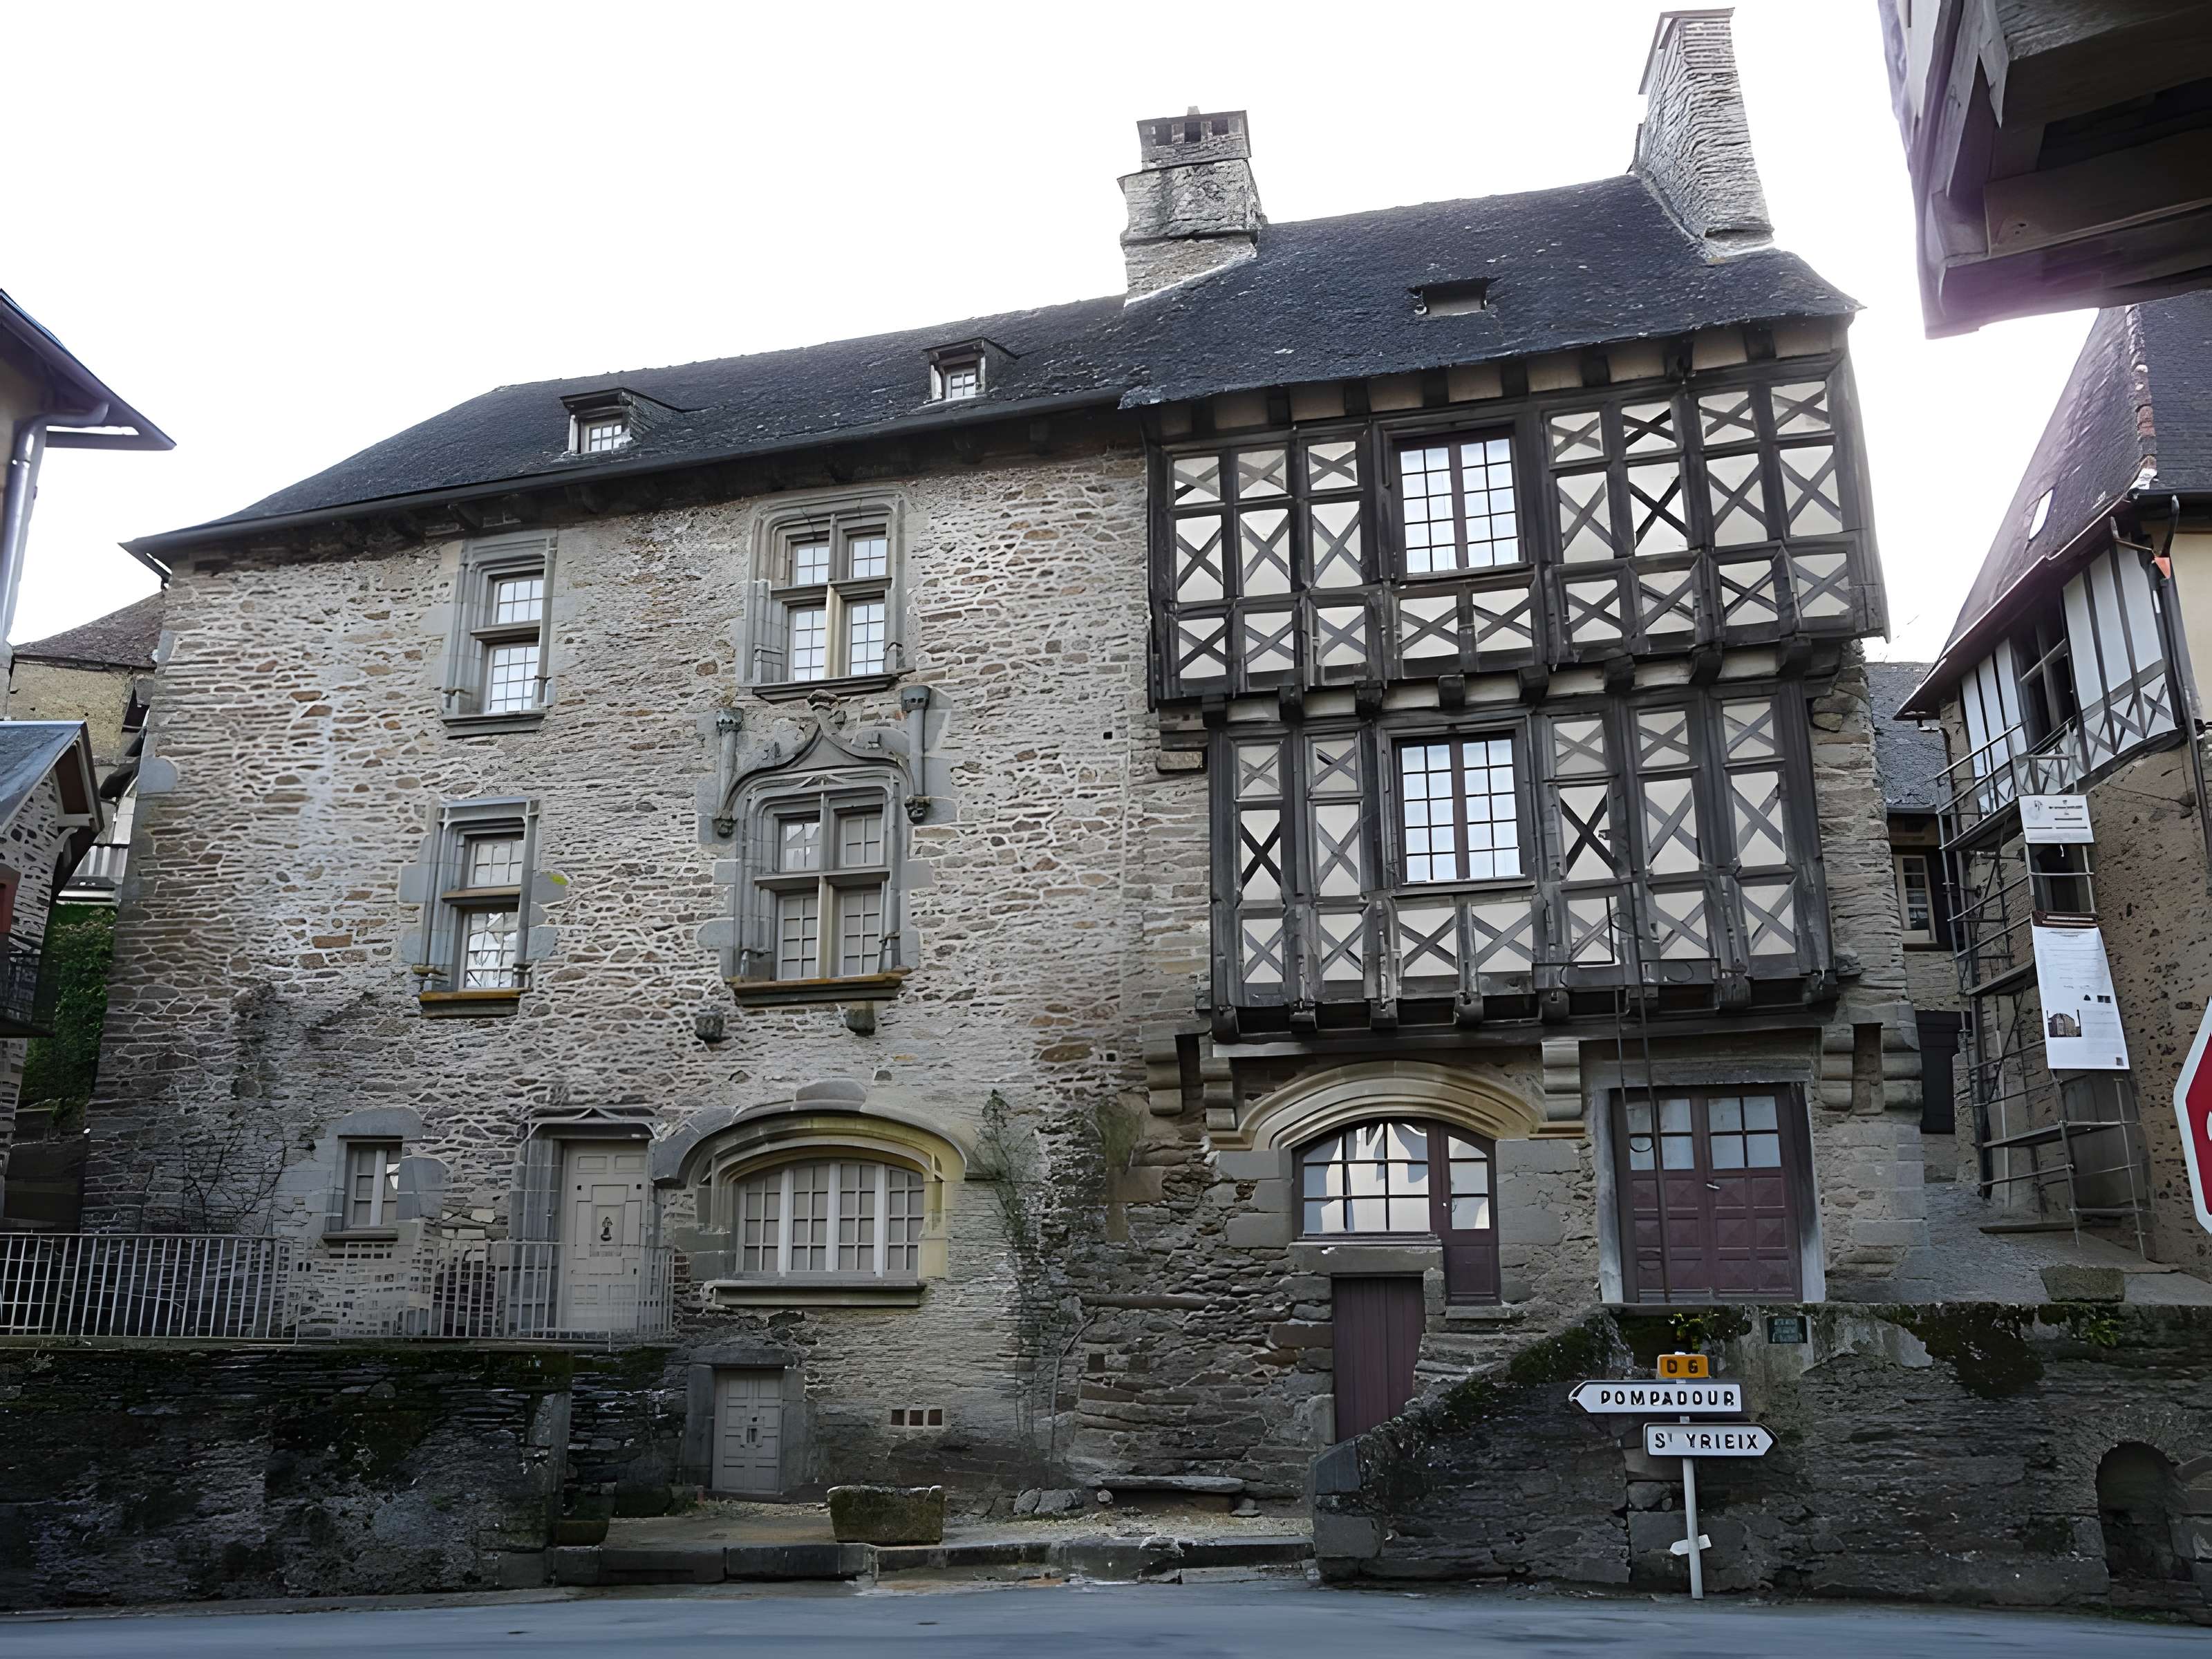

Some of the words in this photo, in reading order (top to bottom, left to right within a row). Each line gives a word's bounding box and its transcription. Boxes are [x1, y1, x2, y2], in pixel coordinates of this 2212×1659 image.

[1667, 1360, 1678, 1374] D
[1601, 1390, 1734, 1406] POMPADOUR
[1686, 1434, 1758, 1450] YRIEIX
